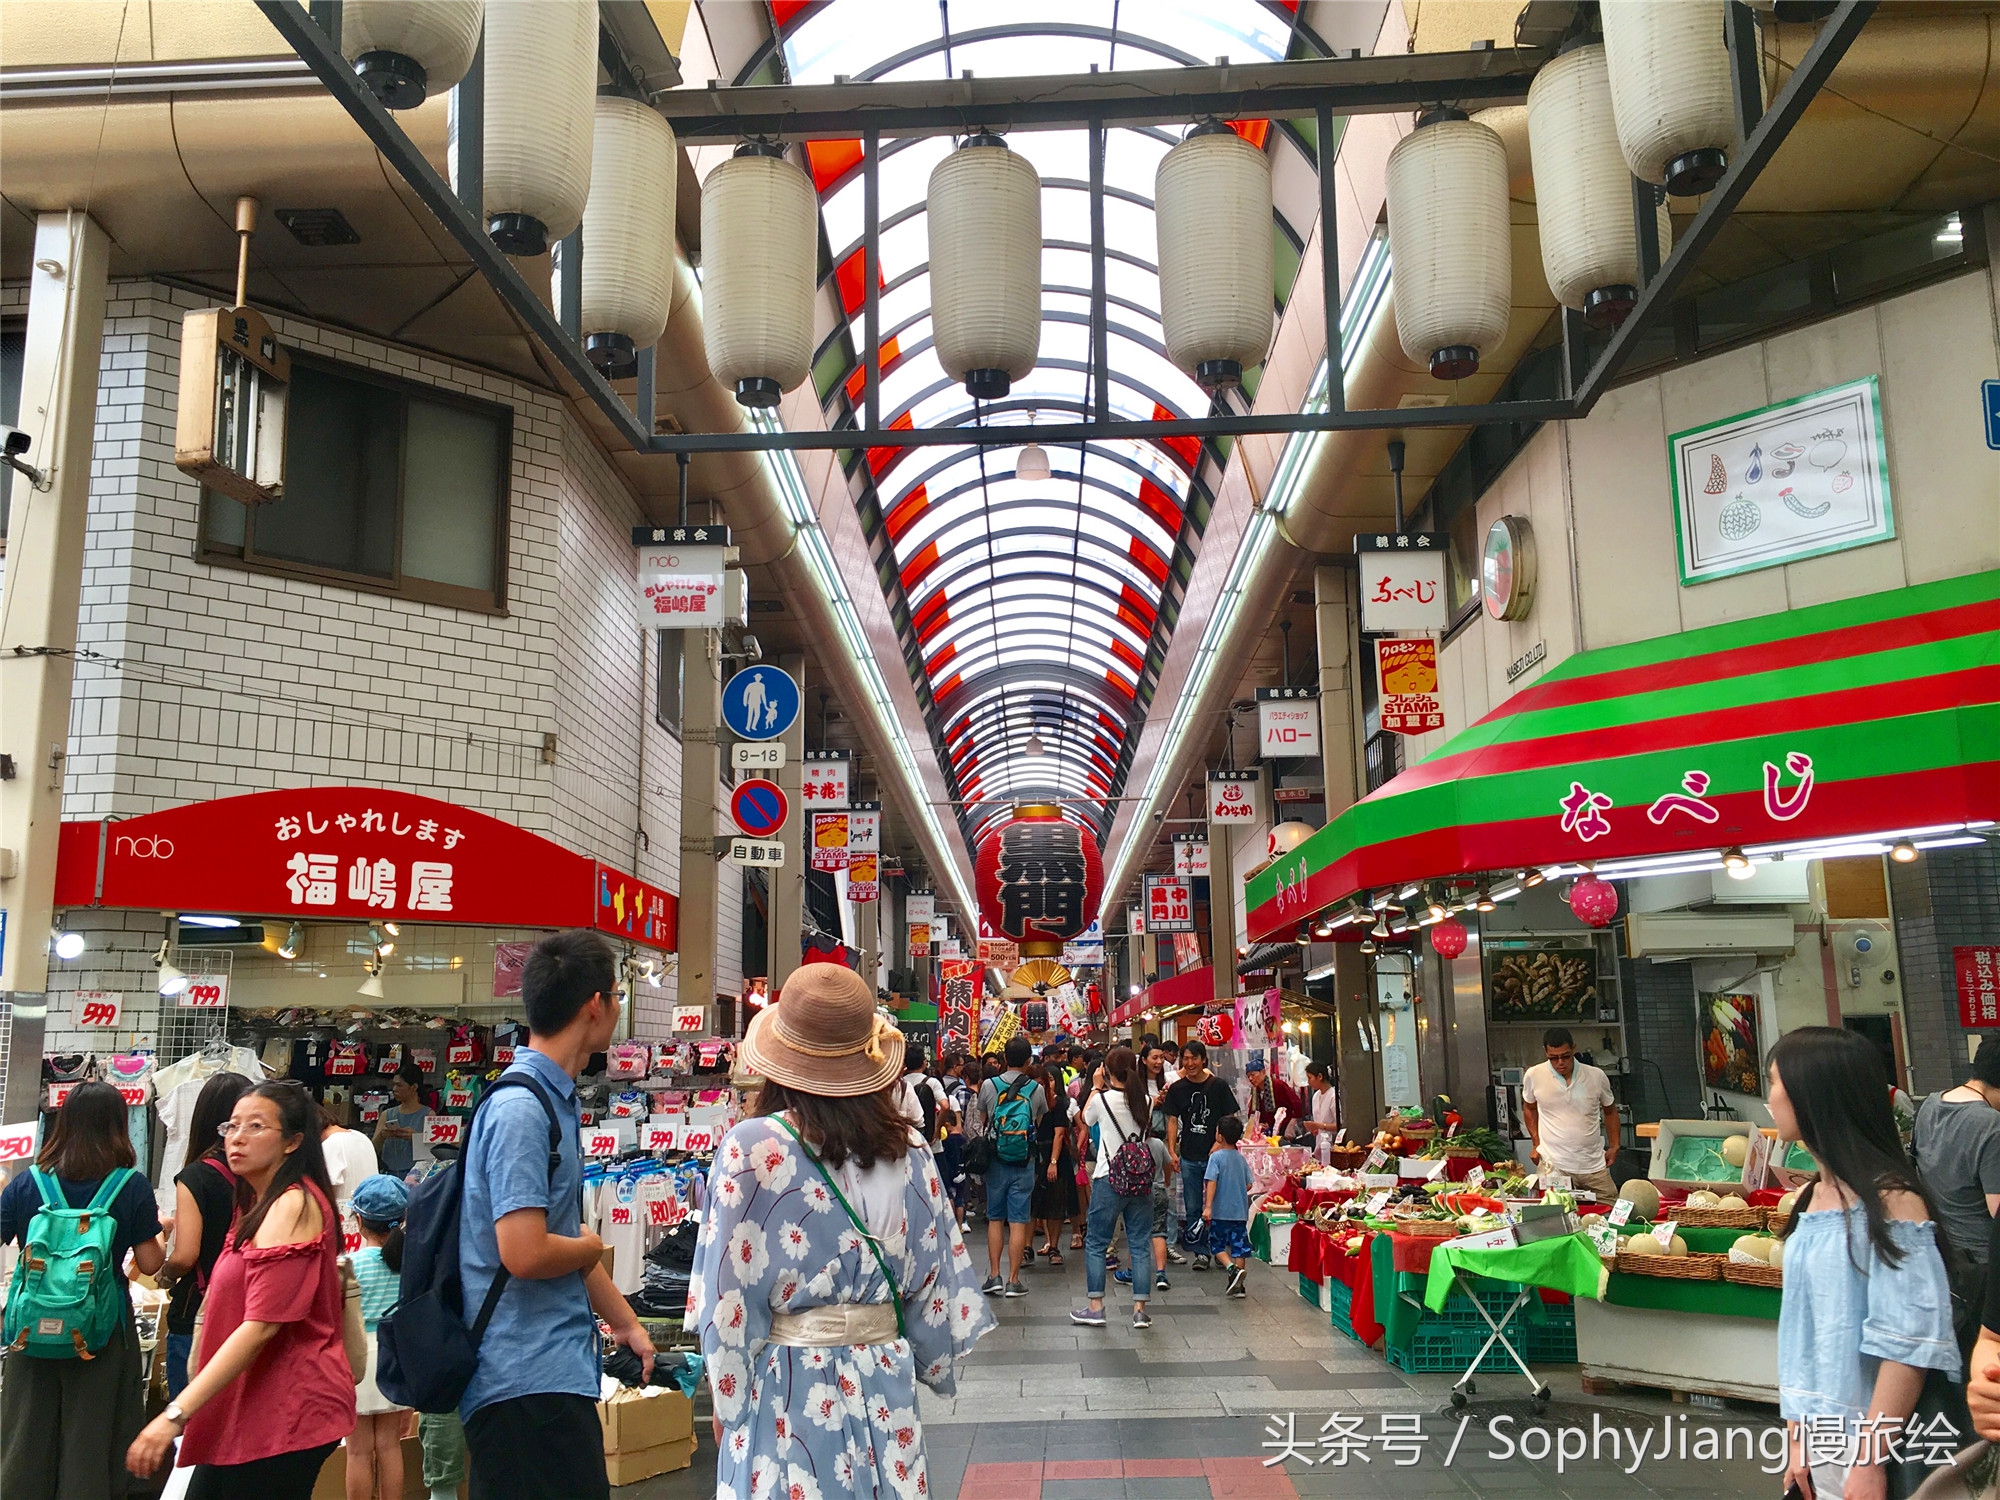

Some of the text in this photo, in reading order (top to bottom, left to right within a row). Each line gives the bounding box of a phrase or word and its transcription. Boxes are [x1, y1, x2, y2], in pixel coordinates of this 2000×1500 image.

[652, 528, 708, 542] 親栄会
[1375, 534, 1430, 548] 親栄会
[648, 555, 680, 568] nob
[643, 578, 718, 599] おしゃれします
[653, 594, 706, 614] 福嶋屋
[1381, 643, 1416, 658] クロモン
[1388, 693, 1432, 703] フレッシュ
[1384, 701, 1440, 714] STAMP
[1269, 711, 1309, 721] バラエティショップ
[1385, 714, 1441, 728] 加盟店
[1267, 728, 1312, 743] ハロー
[739, 749, 778, 762] 9-18
[811, 768, 837, 777] 精肉
[803, 781, 836, 800] 牛兆
[1560, 751, 1814, 842] なべじ
[1214, 801, 1253, 817] わなか
[816, 815, 838, 825] クロモン
[275, 808, 466, 849] おしゃれします
[115, 834, 175, 860] nob
[733, 845, 783, 862] 自動車
[814, 859, 848, 868] 加盟店
[286, 852, 454, 912] 福嶋屋
[996, 821, 1088, 939] 黒門
[1276, 855, 1309, 914] なべじ
[1975, 951, 1997, 1020] 税込み価格
[188, 985, 221, 1005] 799
[1965, 969, 1977, 1023] となっております
[81, 1003, 117, 1025] 599
[677, 1015, 702, 1031] 799
[454, 1051, 471, 1062] 599
[659, 1058, 674, 1068] 799
[701, 1056, 715, 1067] 799
[381, 1062, 399, 1072] 699
[618, 1060, 633, 1071] 799
[450, 1094, 467, 1107] 799
[430, 1124, 458, 1142] 399
[649, 1131, 673, 1149] 599
[590, 1136, 615, 1154] 599
[685, 1133, 711, 1150] 699
[612, 1208, 630, 1224] 599
[1486, 1238, 1507, 1248] トマト
